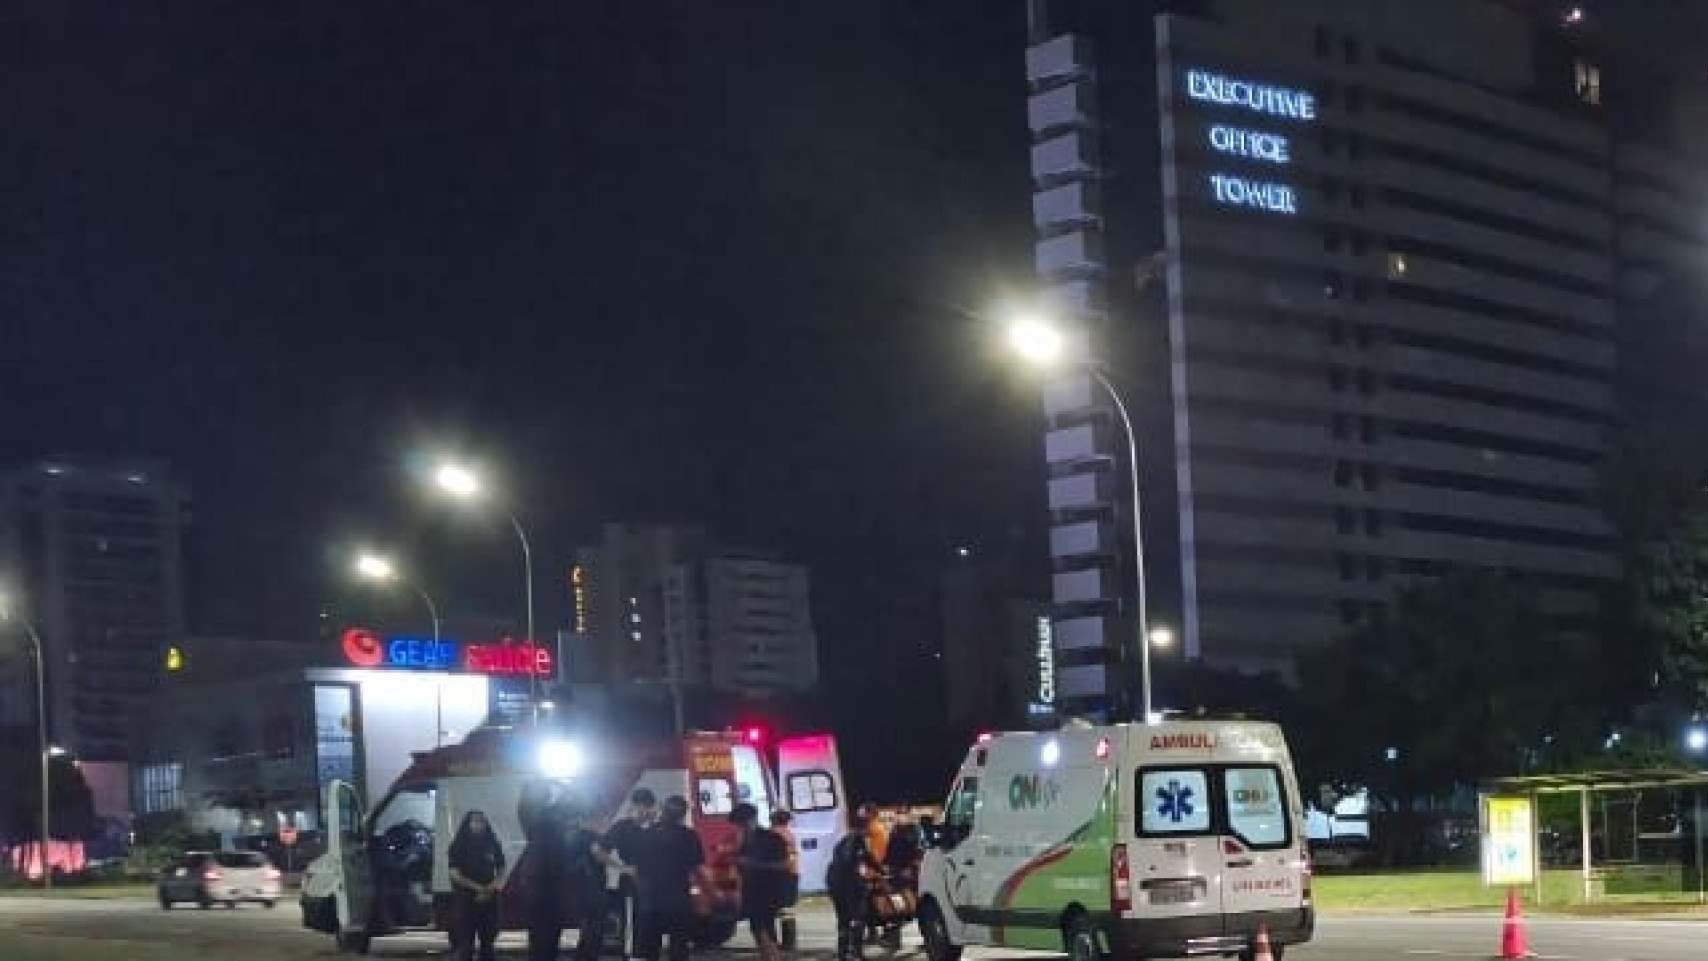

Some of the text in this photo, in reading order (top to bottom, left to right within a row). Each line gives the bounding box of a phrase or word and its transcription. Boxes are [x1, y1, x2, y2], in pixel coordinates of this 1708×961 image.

[1187, 70, 1316, 120] EXECUTIVE
[1210, 126, 1290, 163] OFFICE
[1211, 174, 1296, 213] TOWER
[1151, 731, 1217, 750] AMBUL
